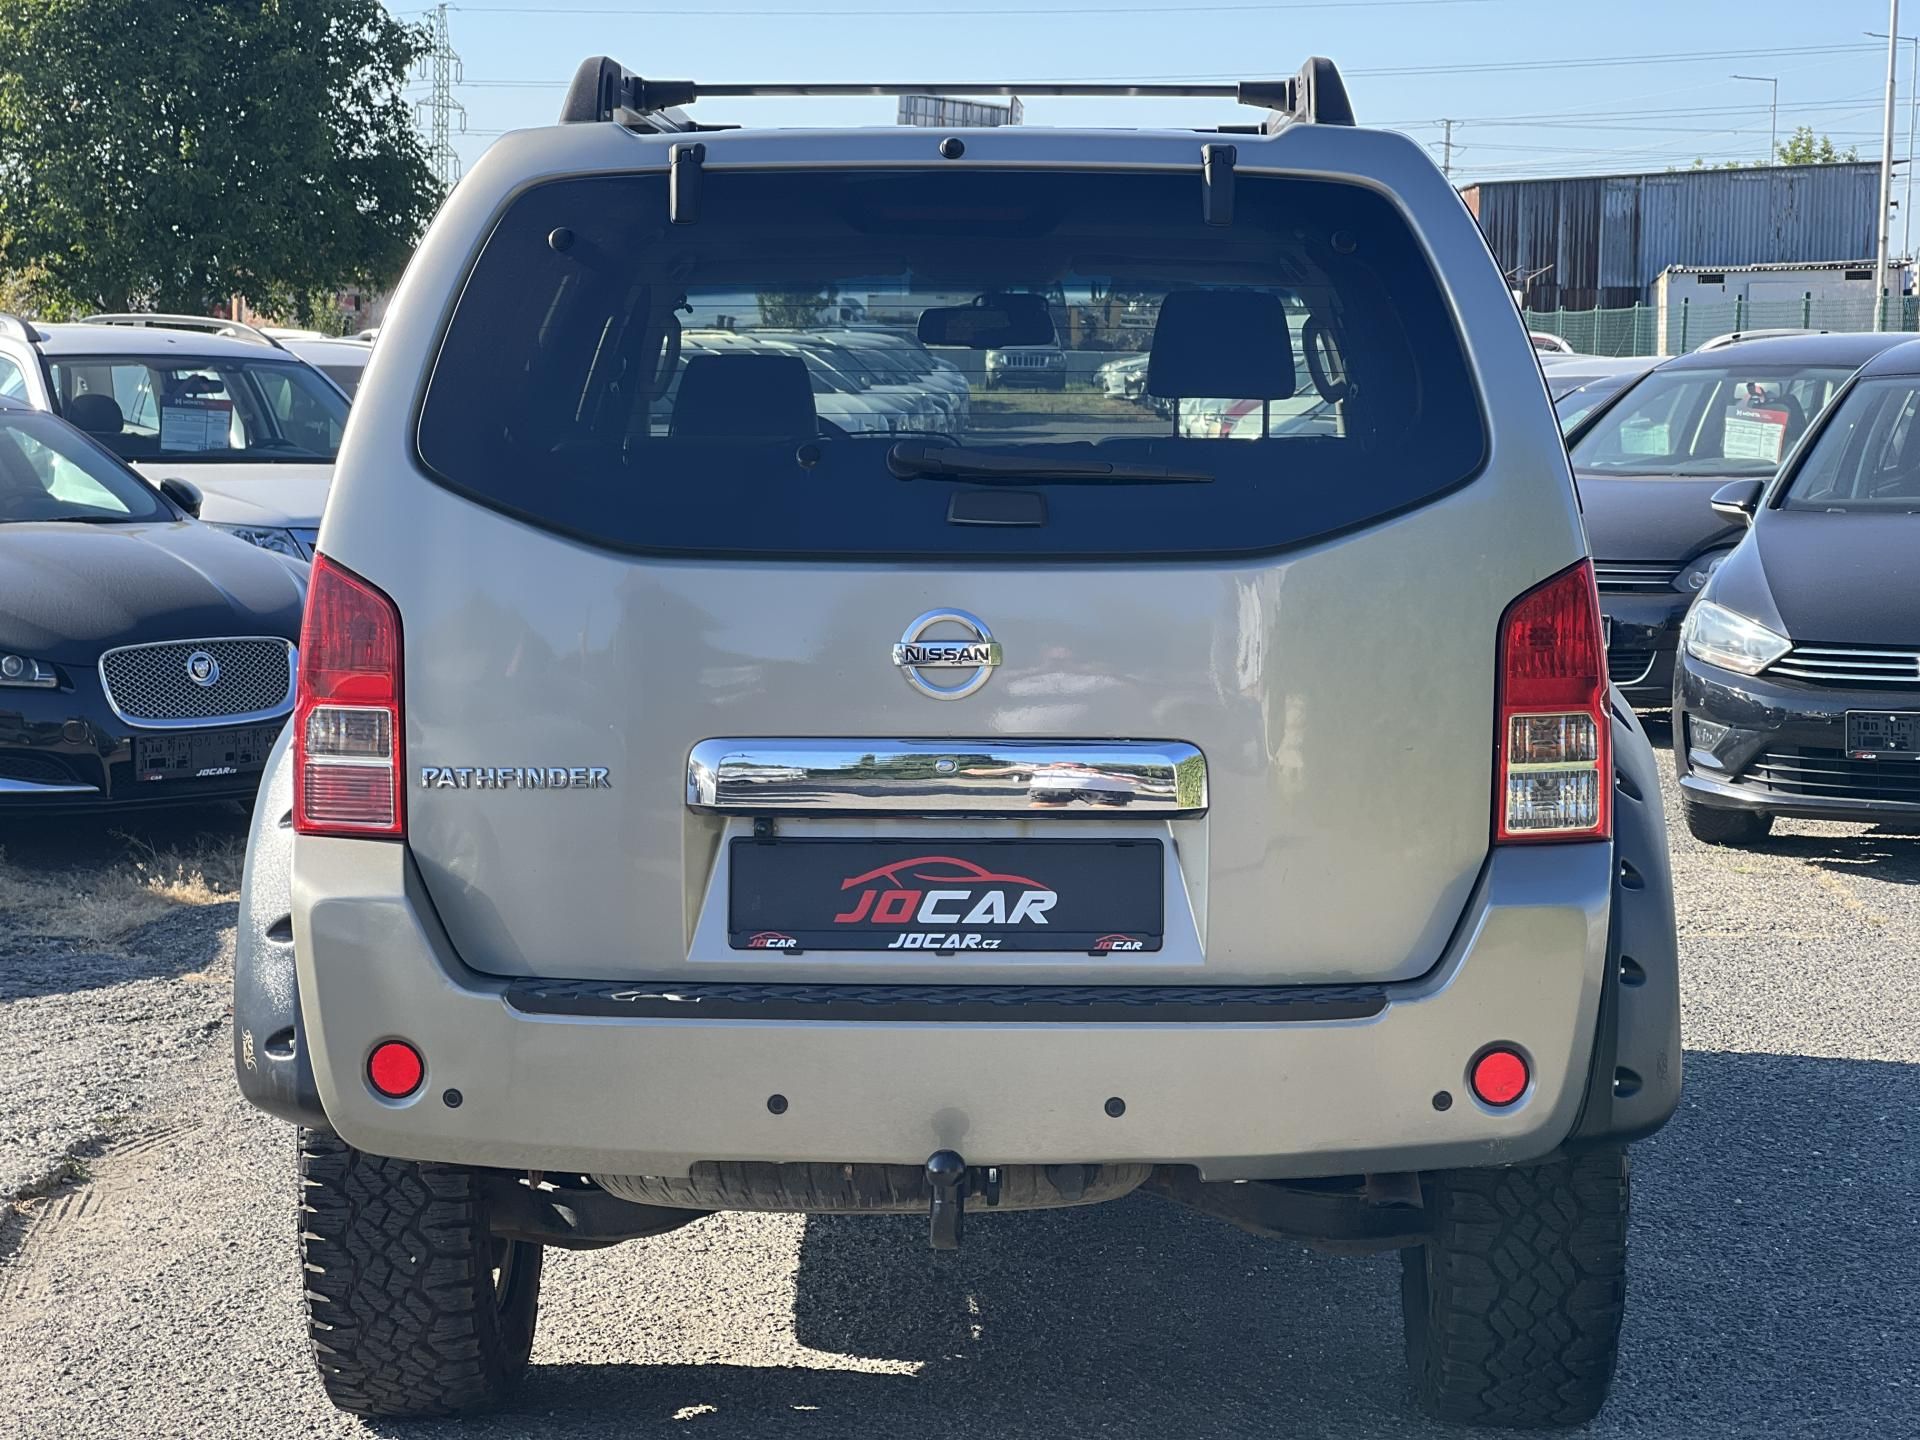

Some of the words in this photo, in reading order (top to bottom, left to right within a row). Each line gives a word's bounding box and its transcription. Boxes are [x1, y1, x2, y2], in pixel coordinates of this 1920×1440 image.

[905, 647, 989, 661] NISSAN
[421, 767, 612, 789] PATHFINDER
[833, 890, 1058, 924] JOCAR
[748, 938, 797, 948] JOCAR
[1093, 941, 1143, 950] JOCAR
